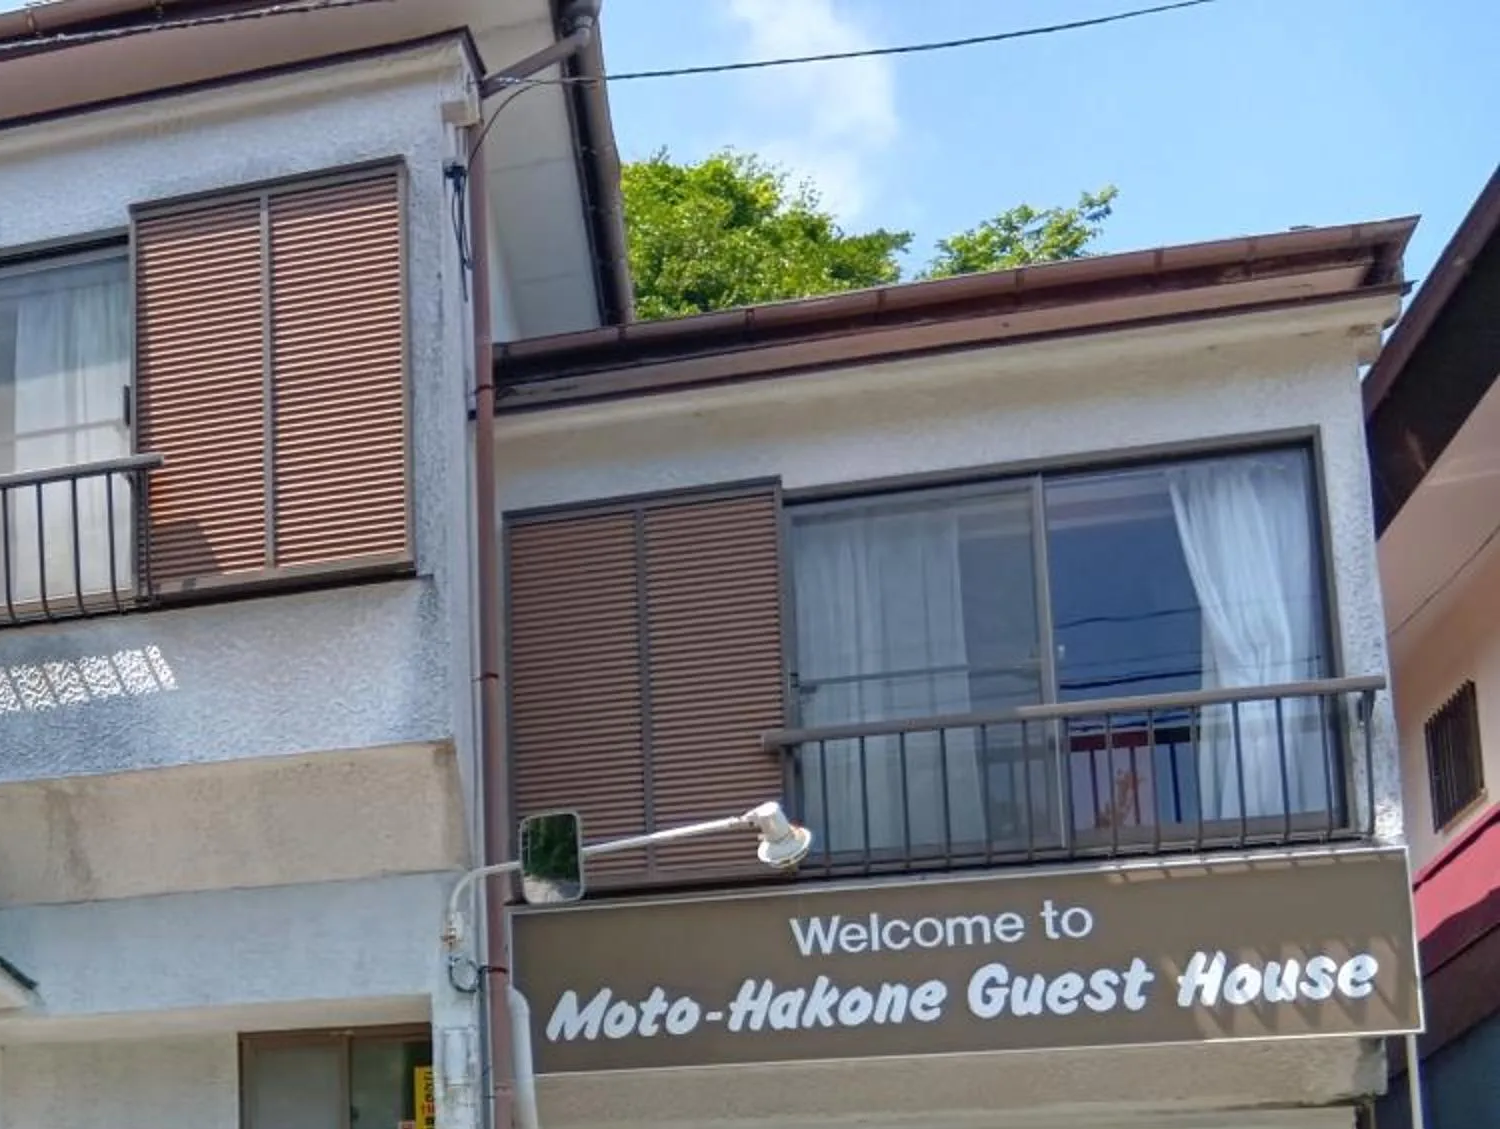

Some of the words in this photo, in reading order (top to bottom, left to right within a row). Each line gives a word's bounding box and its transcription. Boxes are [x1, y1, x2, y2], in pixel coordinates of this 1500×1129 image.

[789, 912, 1025, 956] Welcome
[1039, 900, 1094, 940] to
[545, 975, 948, 1042] Moto-Hakone
[966, 956, 1156, 1019] Guest
[1175, 950, 1380, 1007] House
